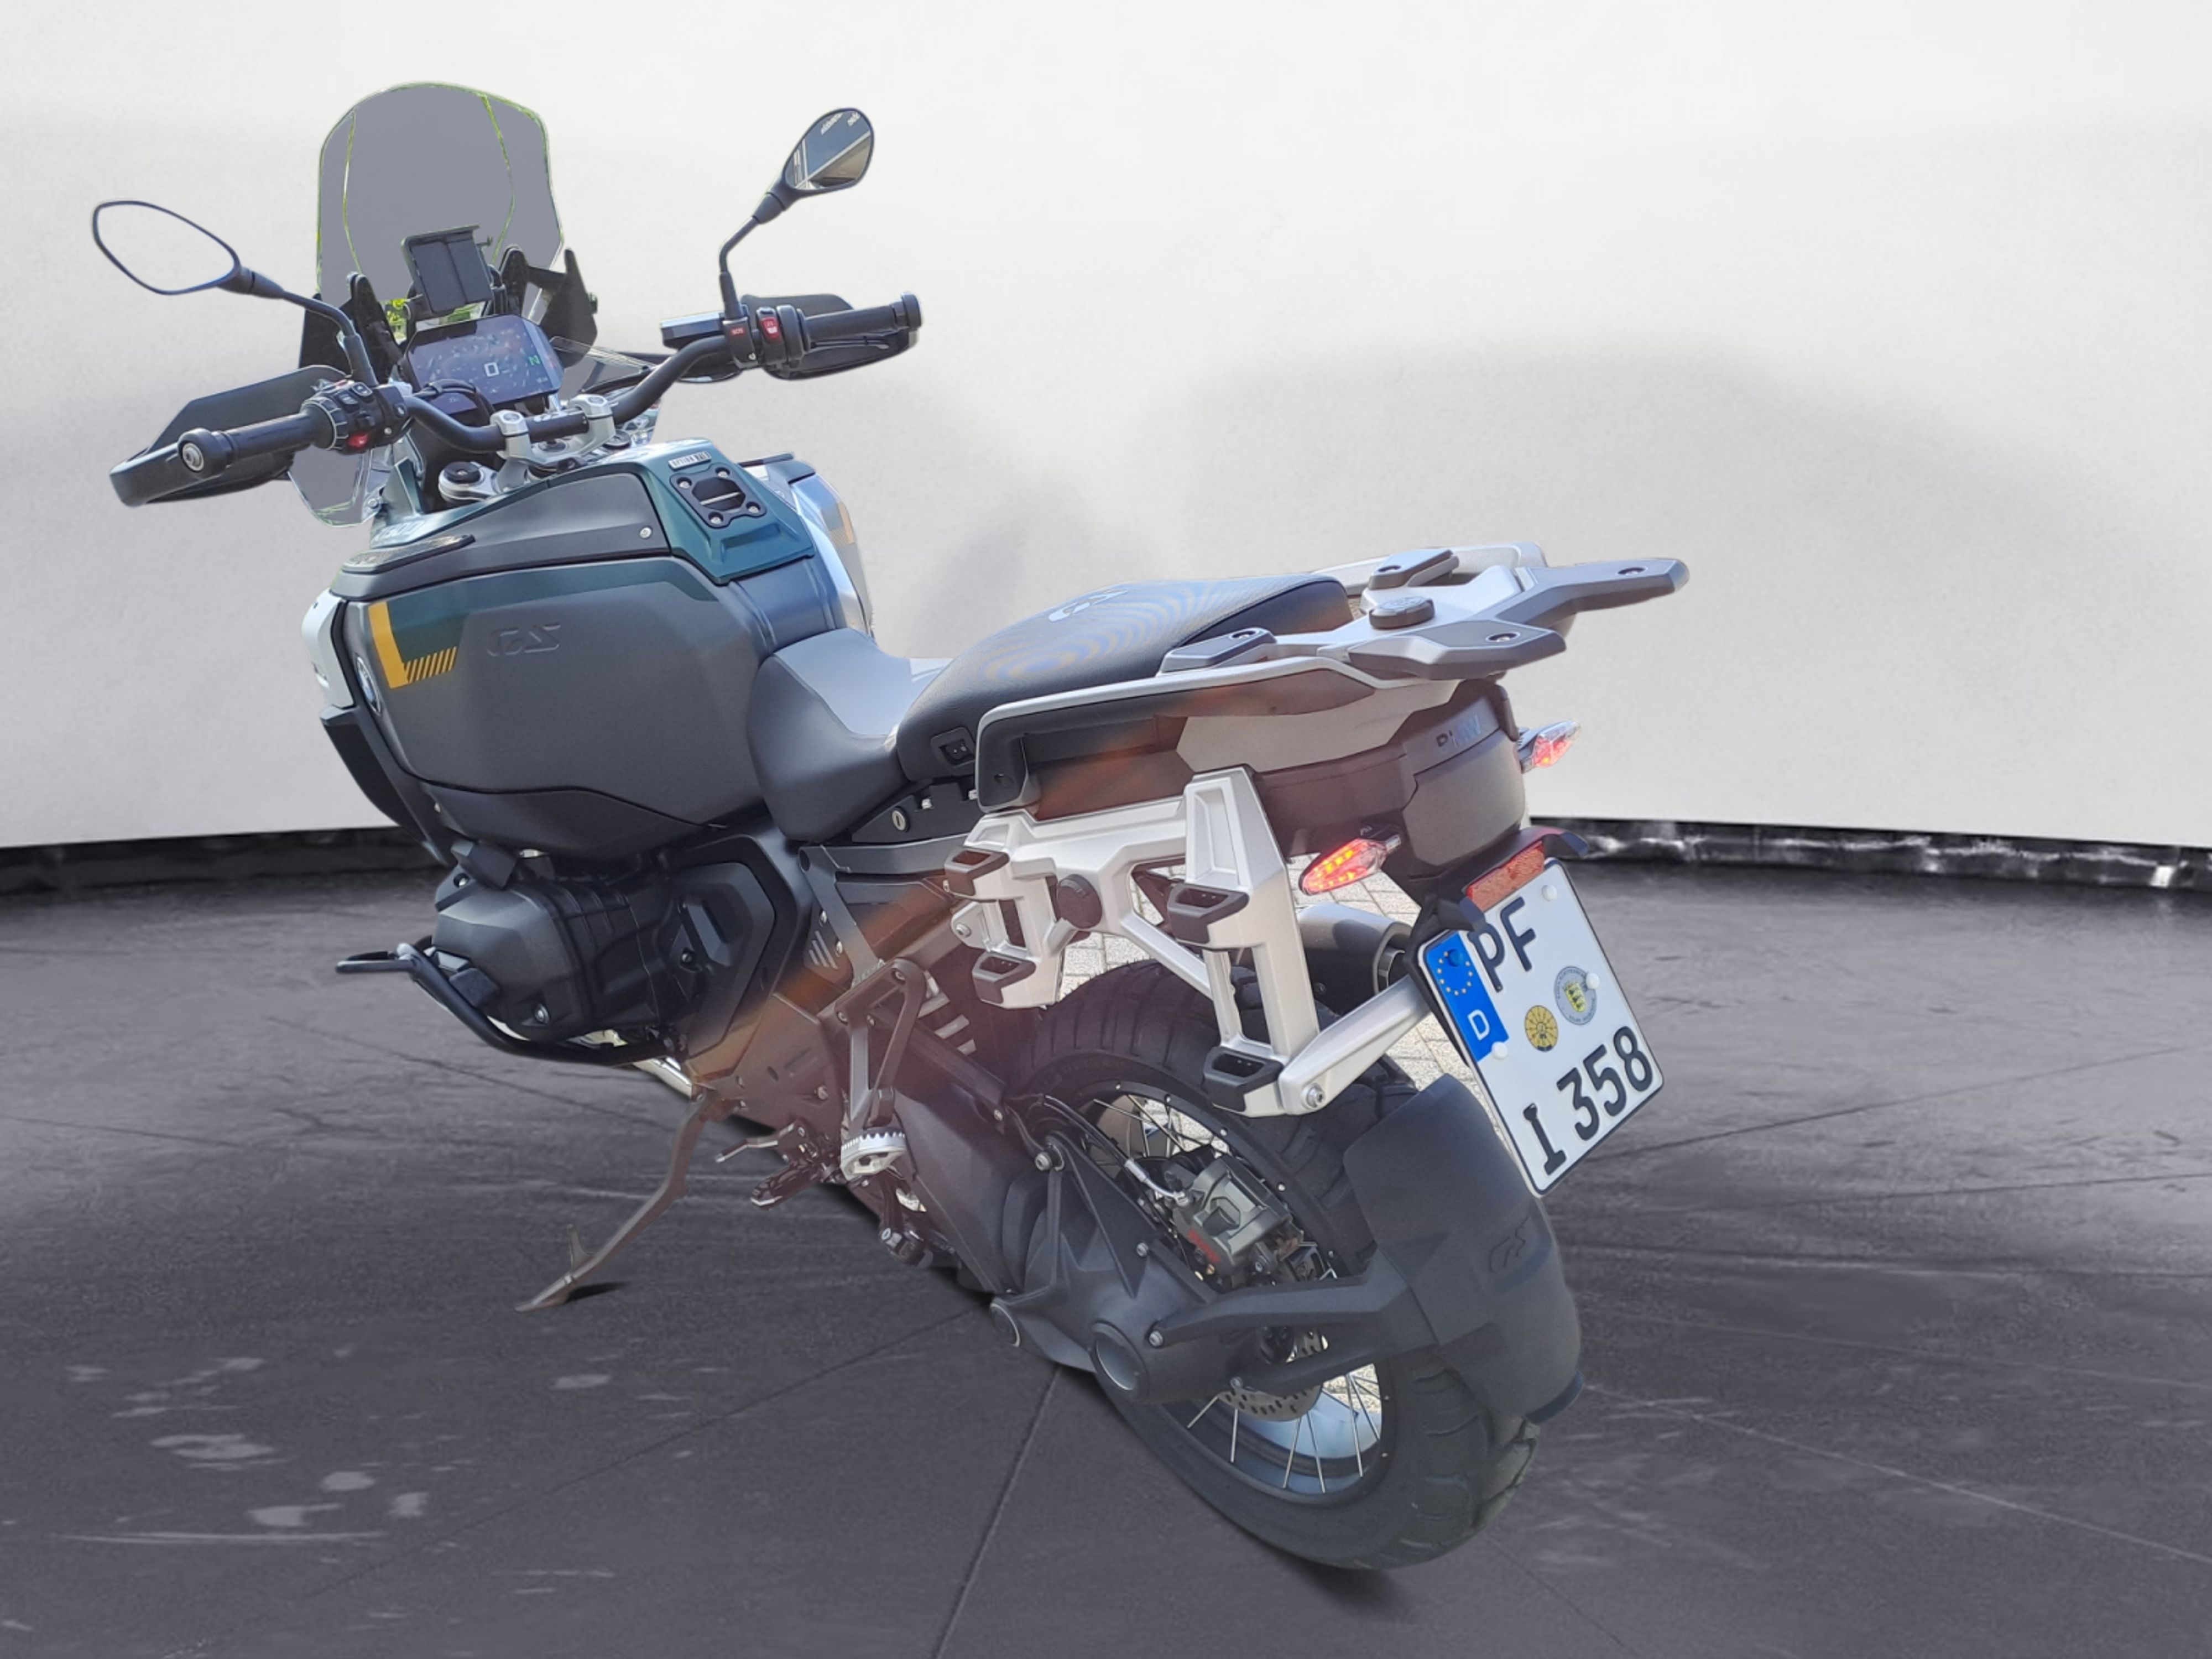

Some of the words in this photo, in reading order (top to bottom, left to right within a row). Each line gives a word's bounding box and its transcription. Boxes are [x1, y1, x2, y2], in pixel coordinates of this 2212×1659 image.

[1467, 896, 1536, 993] PF
[1467, 1009, 1490, 1040] D
[1523, 1103, 1567, 1176] I
[1556, 1025, 1653, 1141] 358
